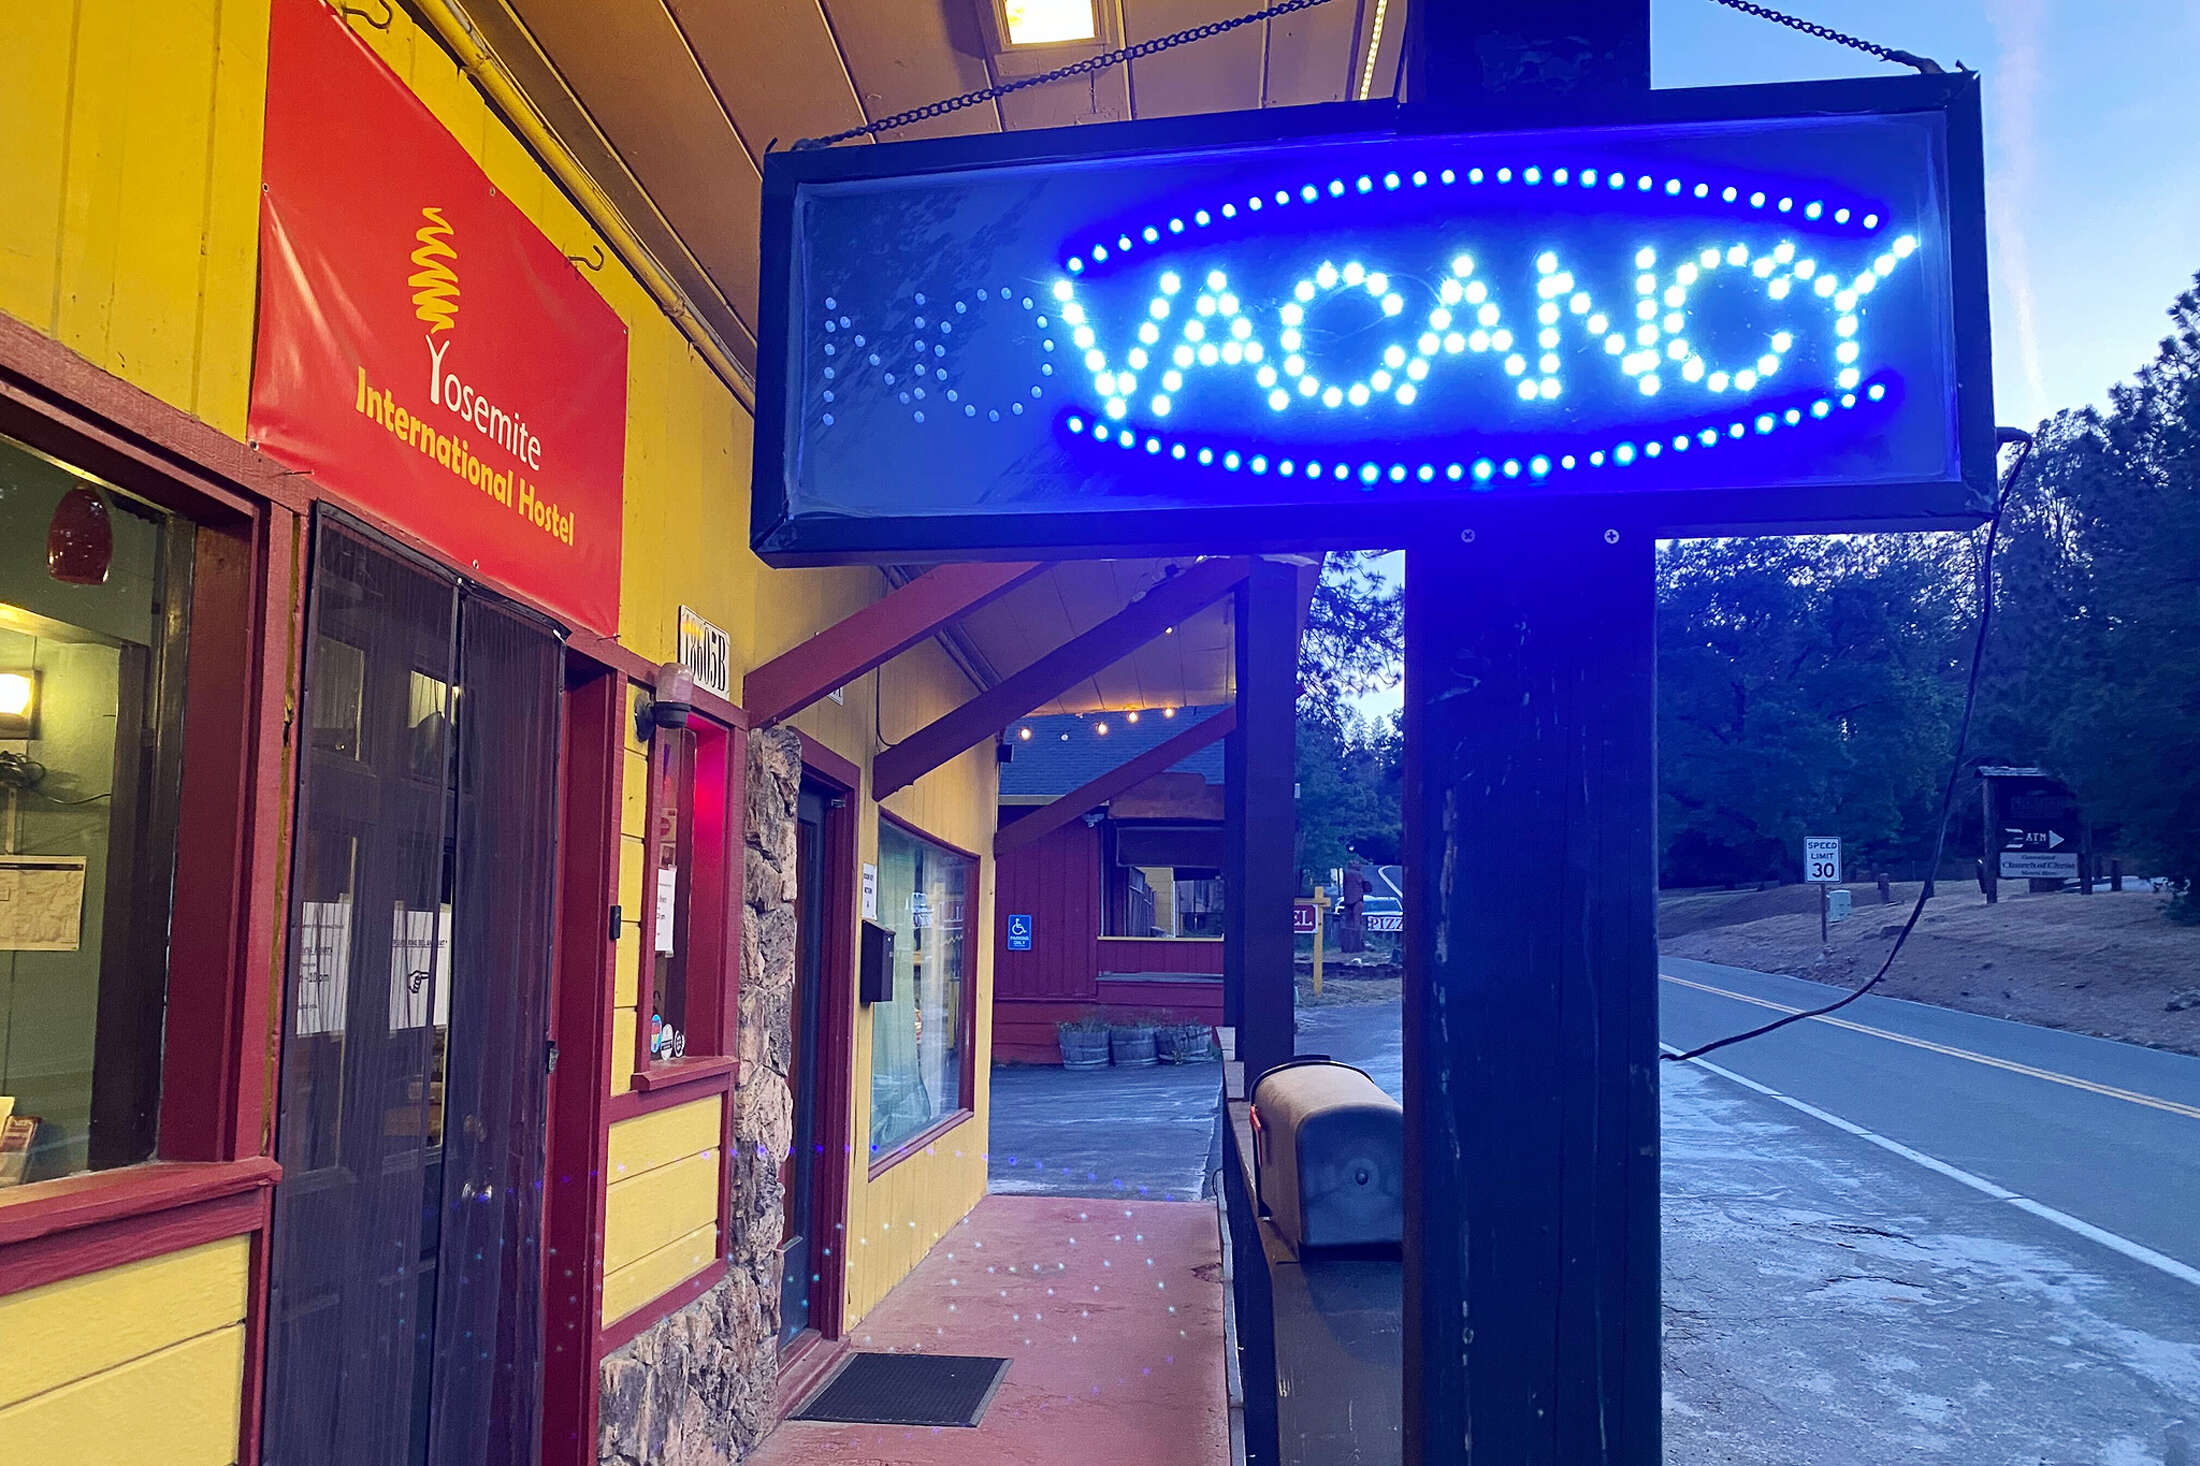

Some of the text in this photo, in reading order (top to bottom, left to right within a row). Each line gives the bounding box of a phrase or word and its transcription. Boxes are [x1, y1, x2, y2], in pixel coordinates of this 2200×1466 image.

[823, 232, 1919, 426] NO VACANCY
[425, 334, 542, 471] Yosemite
[355, 365, 574, 546] International Hostel
[2026, 832, 2047, 842] ATM
[1808, 841, 1838, 850] SPEED
[1811, 852, 1834, 860] LIMIT
[1812, 862, 1835, 878] 30
